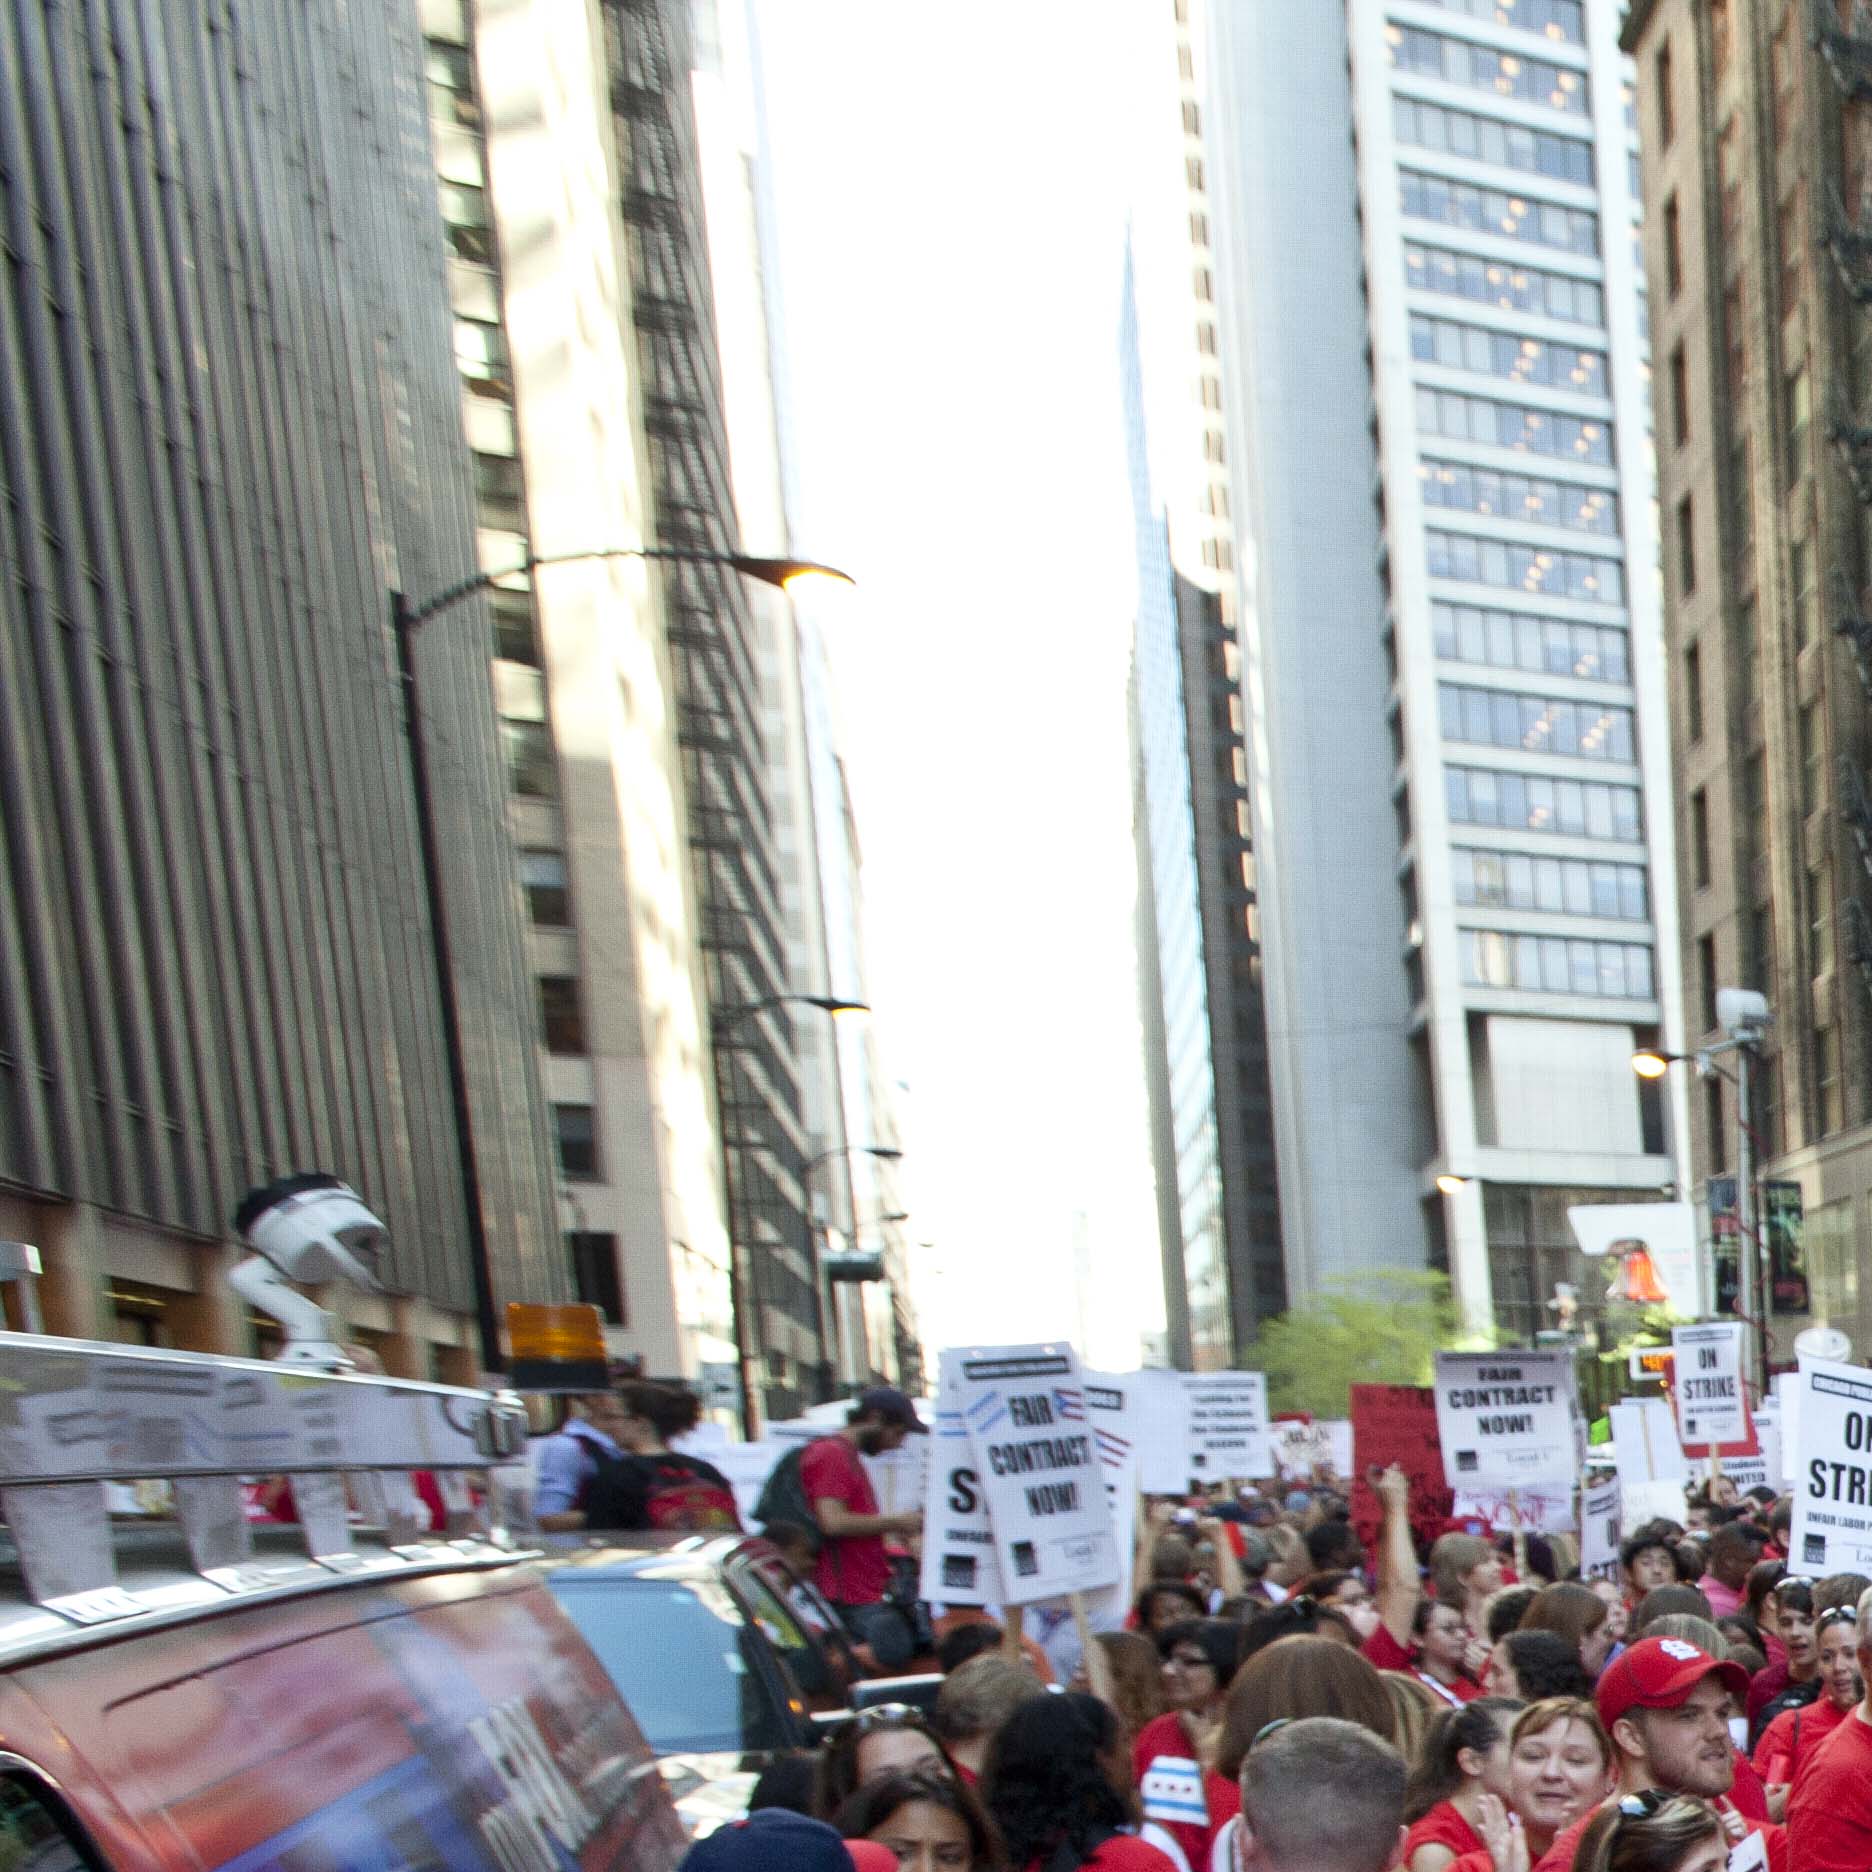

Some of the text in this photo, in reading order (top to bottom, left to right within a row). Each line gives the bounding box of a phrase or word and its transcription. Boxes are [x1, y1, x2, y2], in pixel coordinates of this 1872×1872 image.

[1698, 1348, 1718, 1370] ON
[1477, 1366, 1522, 1382] FAIR
[1447, 1385, 1555, 1410] CONTRACT
[1683, 1375, 1736, 1401] STRIKE
[1007, 1393, 1055, 1427] FAIR
[1477, 1413, 1534, 1436] NOW!
[987, 1435, 1091, 1476] CONTRACT
[1023, 1480, 1080, 1518] NOW!
[1806, 1511, 1866, 1532] UNFAIR LABOR
